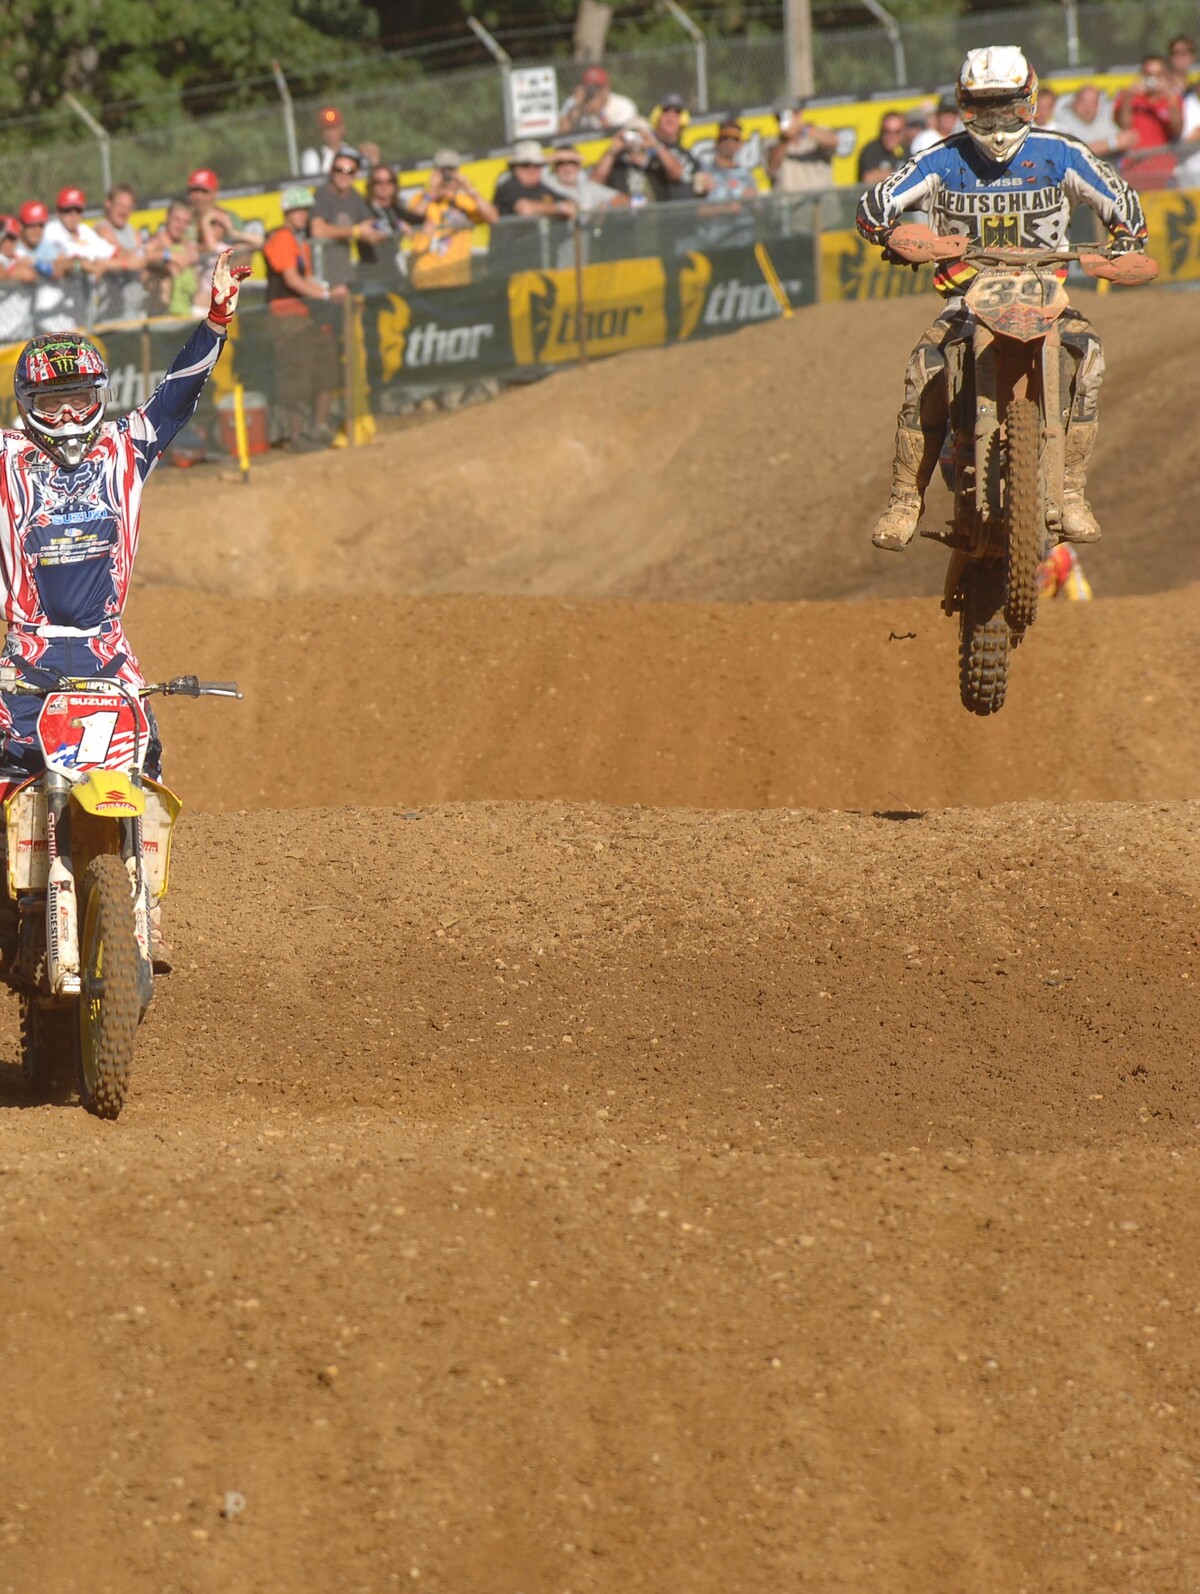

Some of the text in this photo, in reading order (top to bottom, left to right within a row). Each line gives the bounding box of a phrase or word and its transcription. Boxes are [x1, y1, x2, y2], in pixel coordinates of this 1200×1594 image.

[405, 322, 494, 368] thor
[51, 509, 108, 526] SUZUKI
[69, 697, 118, 707] SUZUKI
[71, 711, 120, 764] 1
